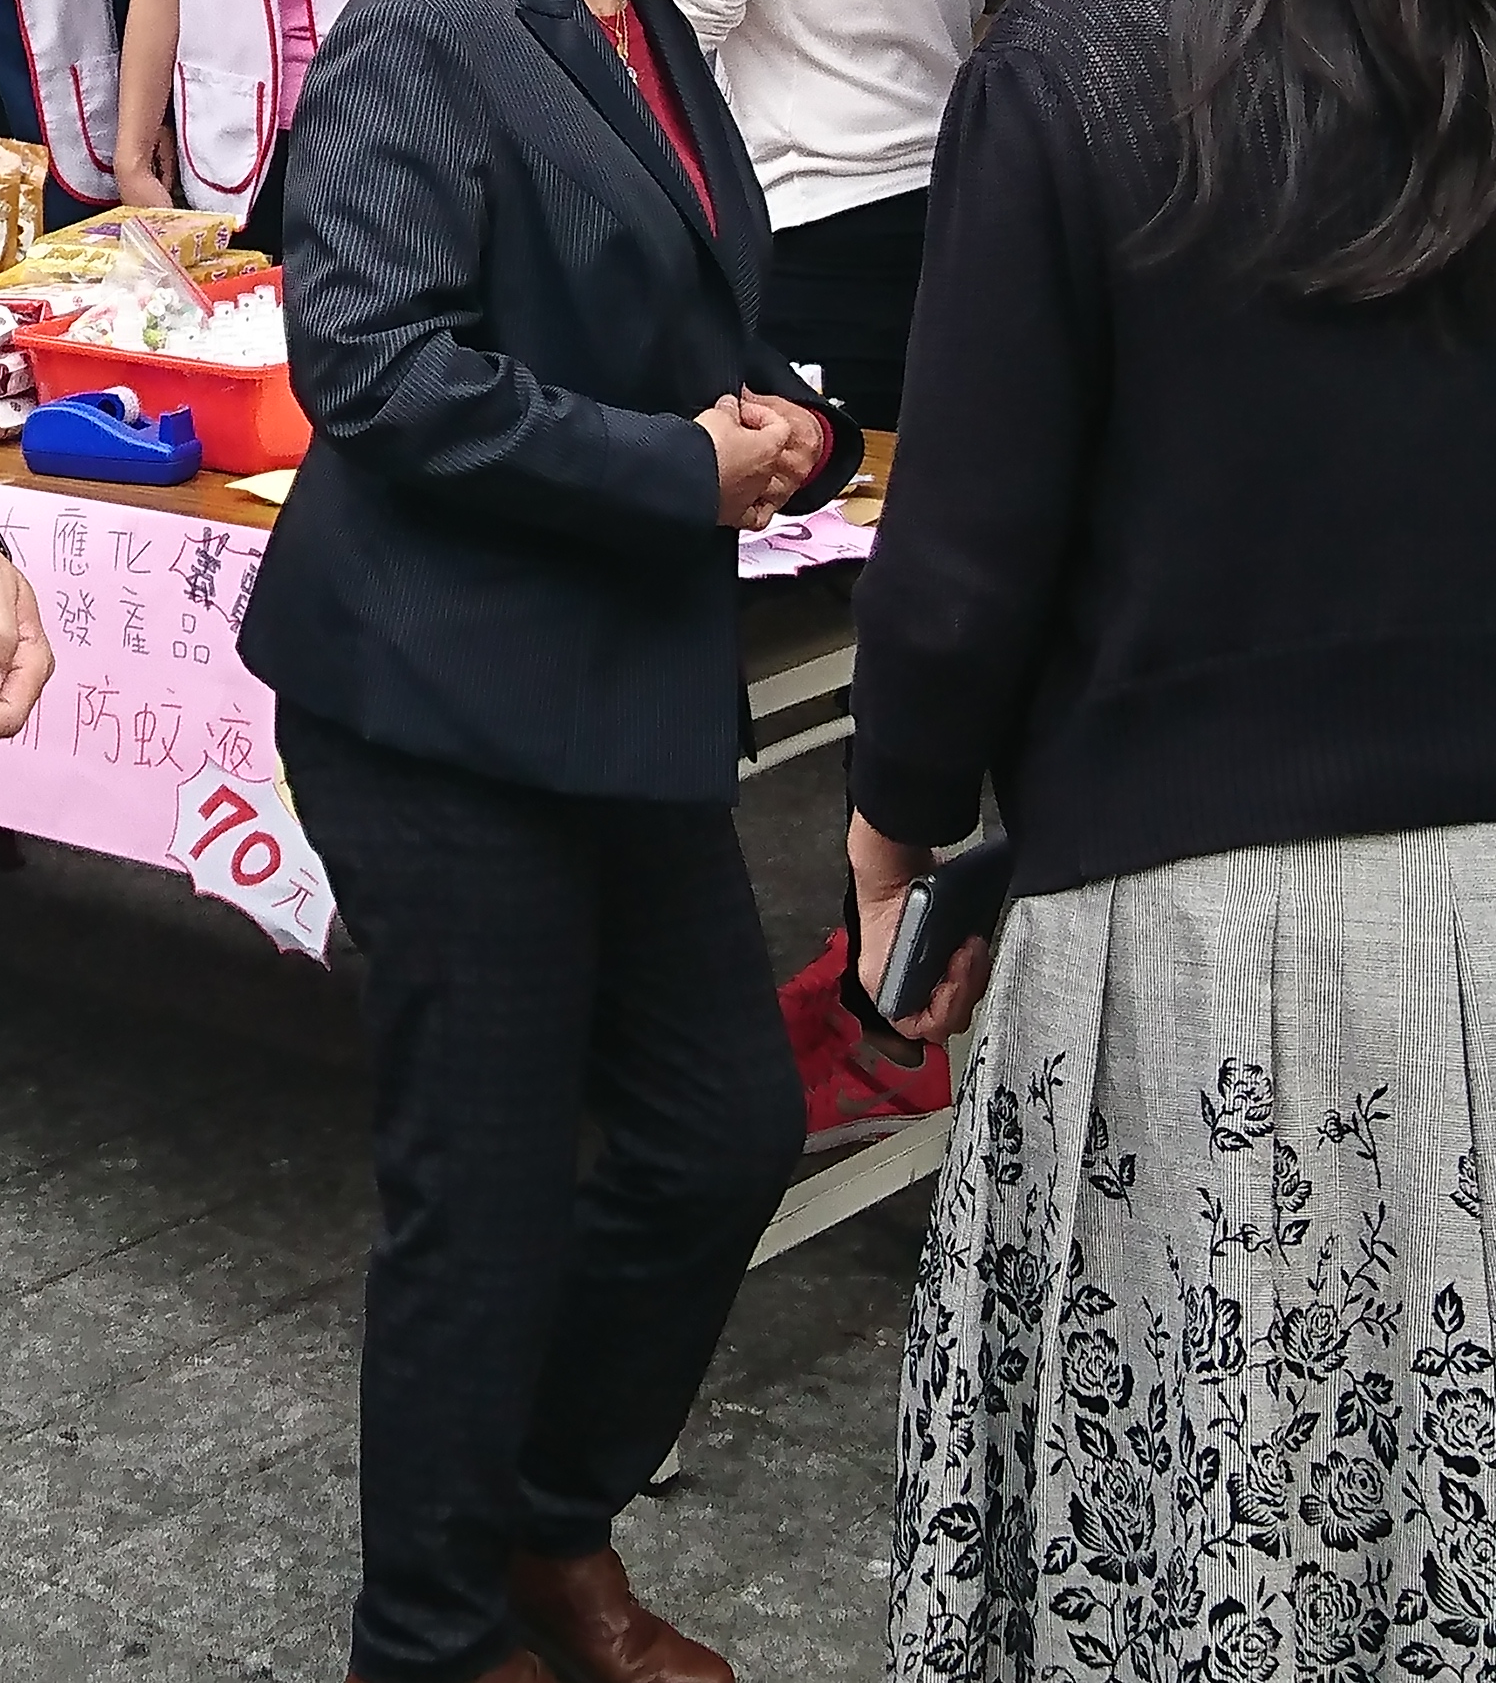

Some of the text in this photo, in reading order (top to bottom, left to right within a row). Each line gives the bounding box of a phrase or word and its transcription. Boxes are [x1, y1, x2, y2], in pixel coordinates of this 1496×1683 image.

[56, 586, 210, 665] 發產品
[9, 674, 257, 780] 防蚊液
[188, 783, 321, 934] 70元
